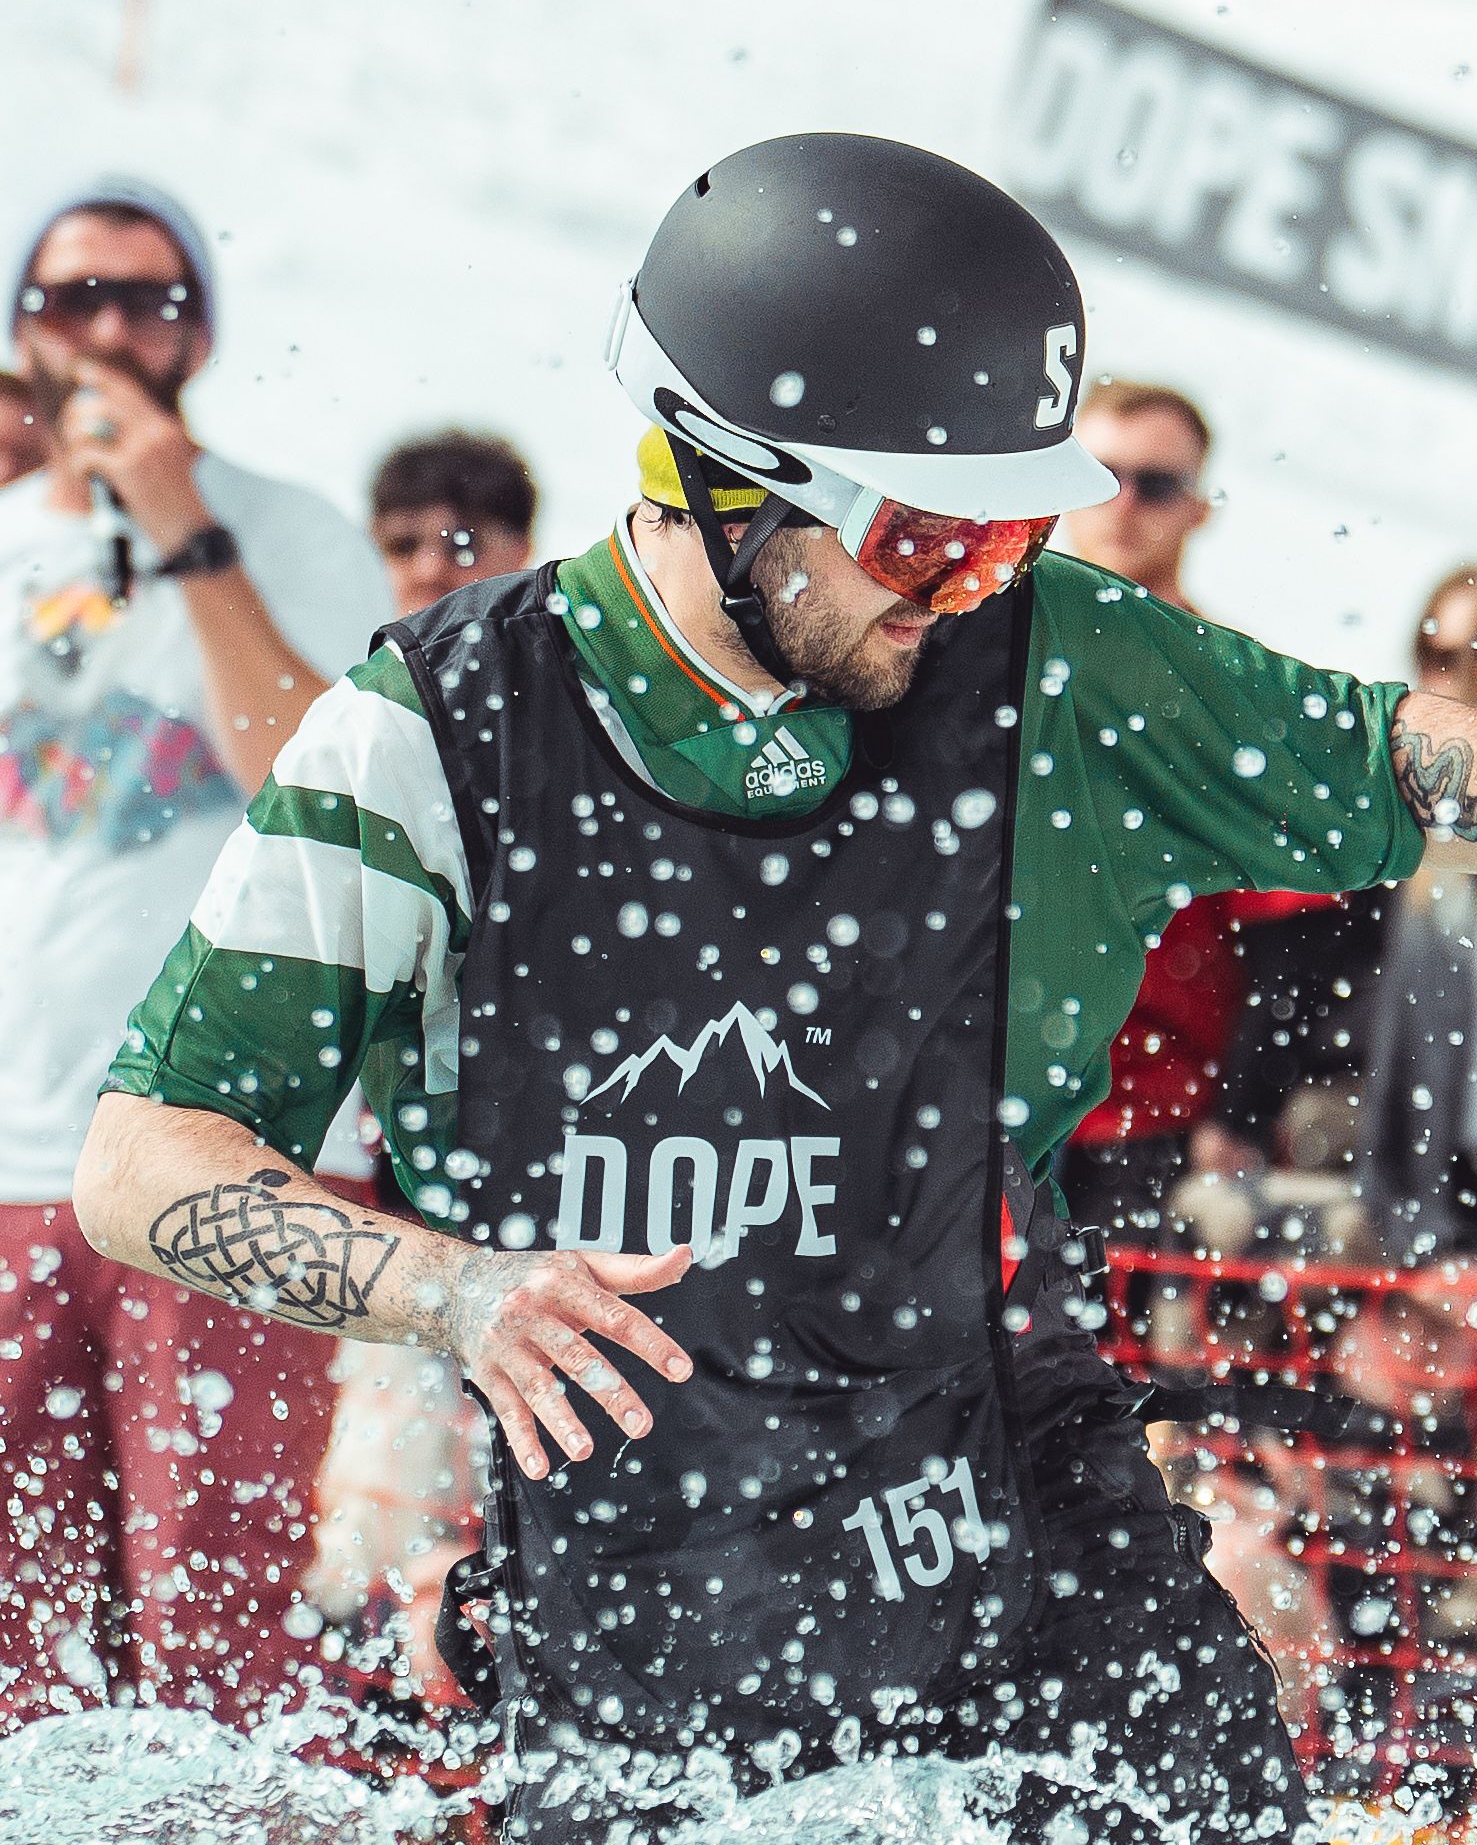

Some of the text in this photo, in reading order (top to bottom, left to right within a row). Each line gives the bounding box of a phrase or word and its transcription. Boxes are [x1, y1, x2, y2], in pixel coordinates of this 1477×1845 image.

[1010, 14, 1340, 282] DOPE
[745, 759, 826, 789] adidas
[746, 776, 827, 799] EQUENT
[804, 1026, 833, 1047] TM
[555, 1134, 841, 1263] DOPE
